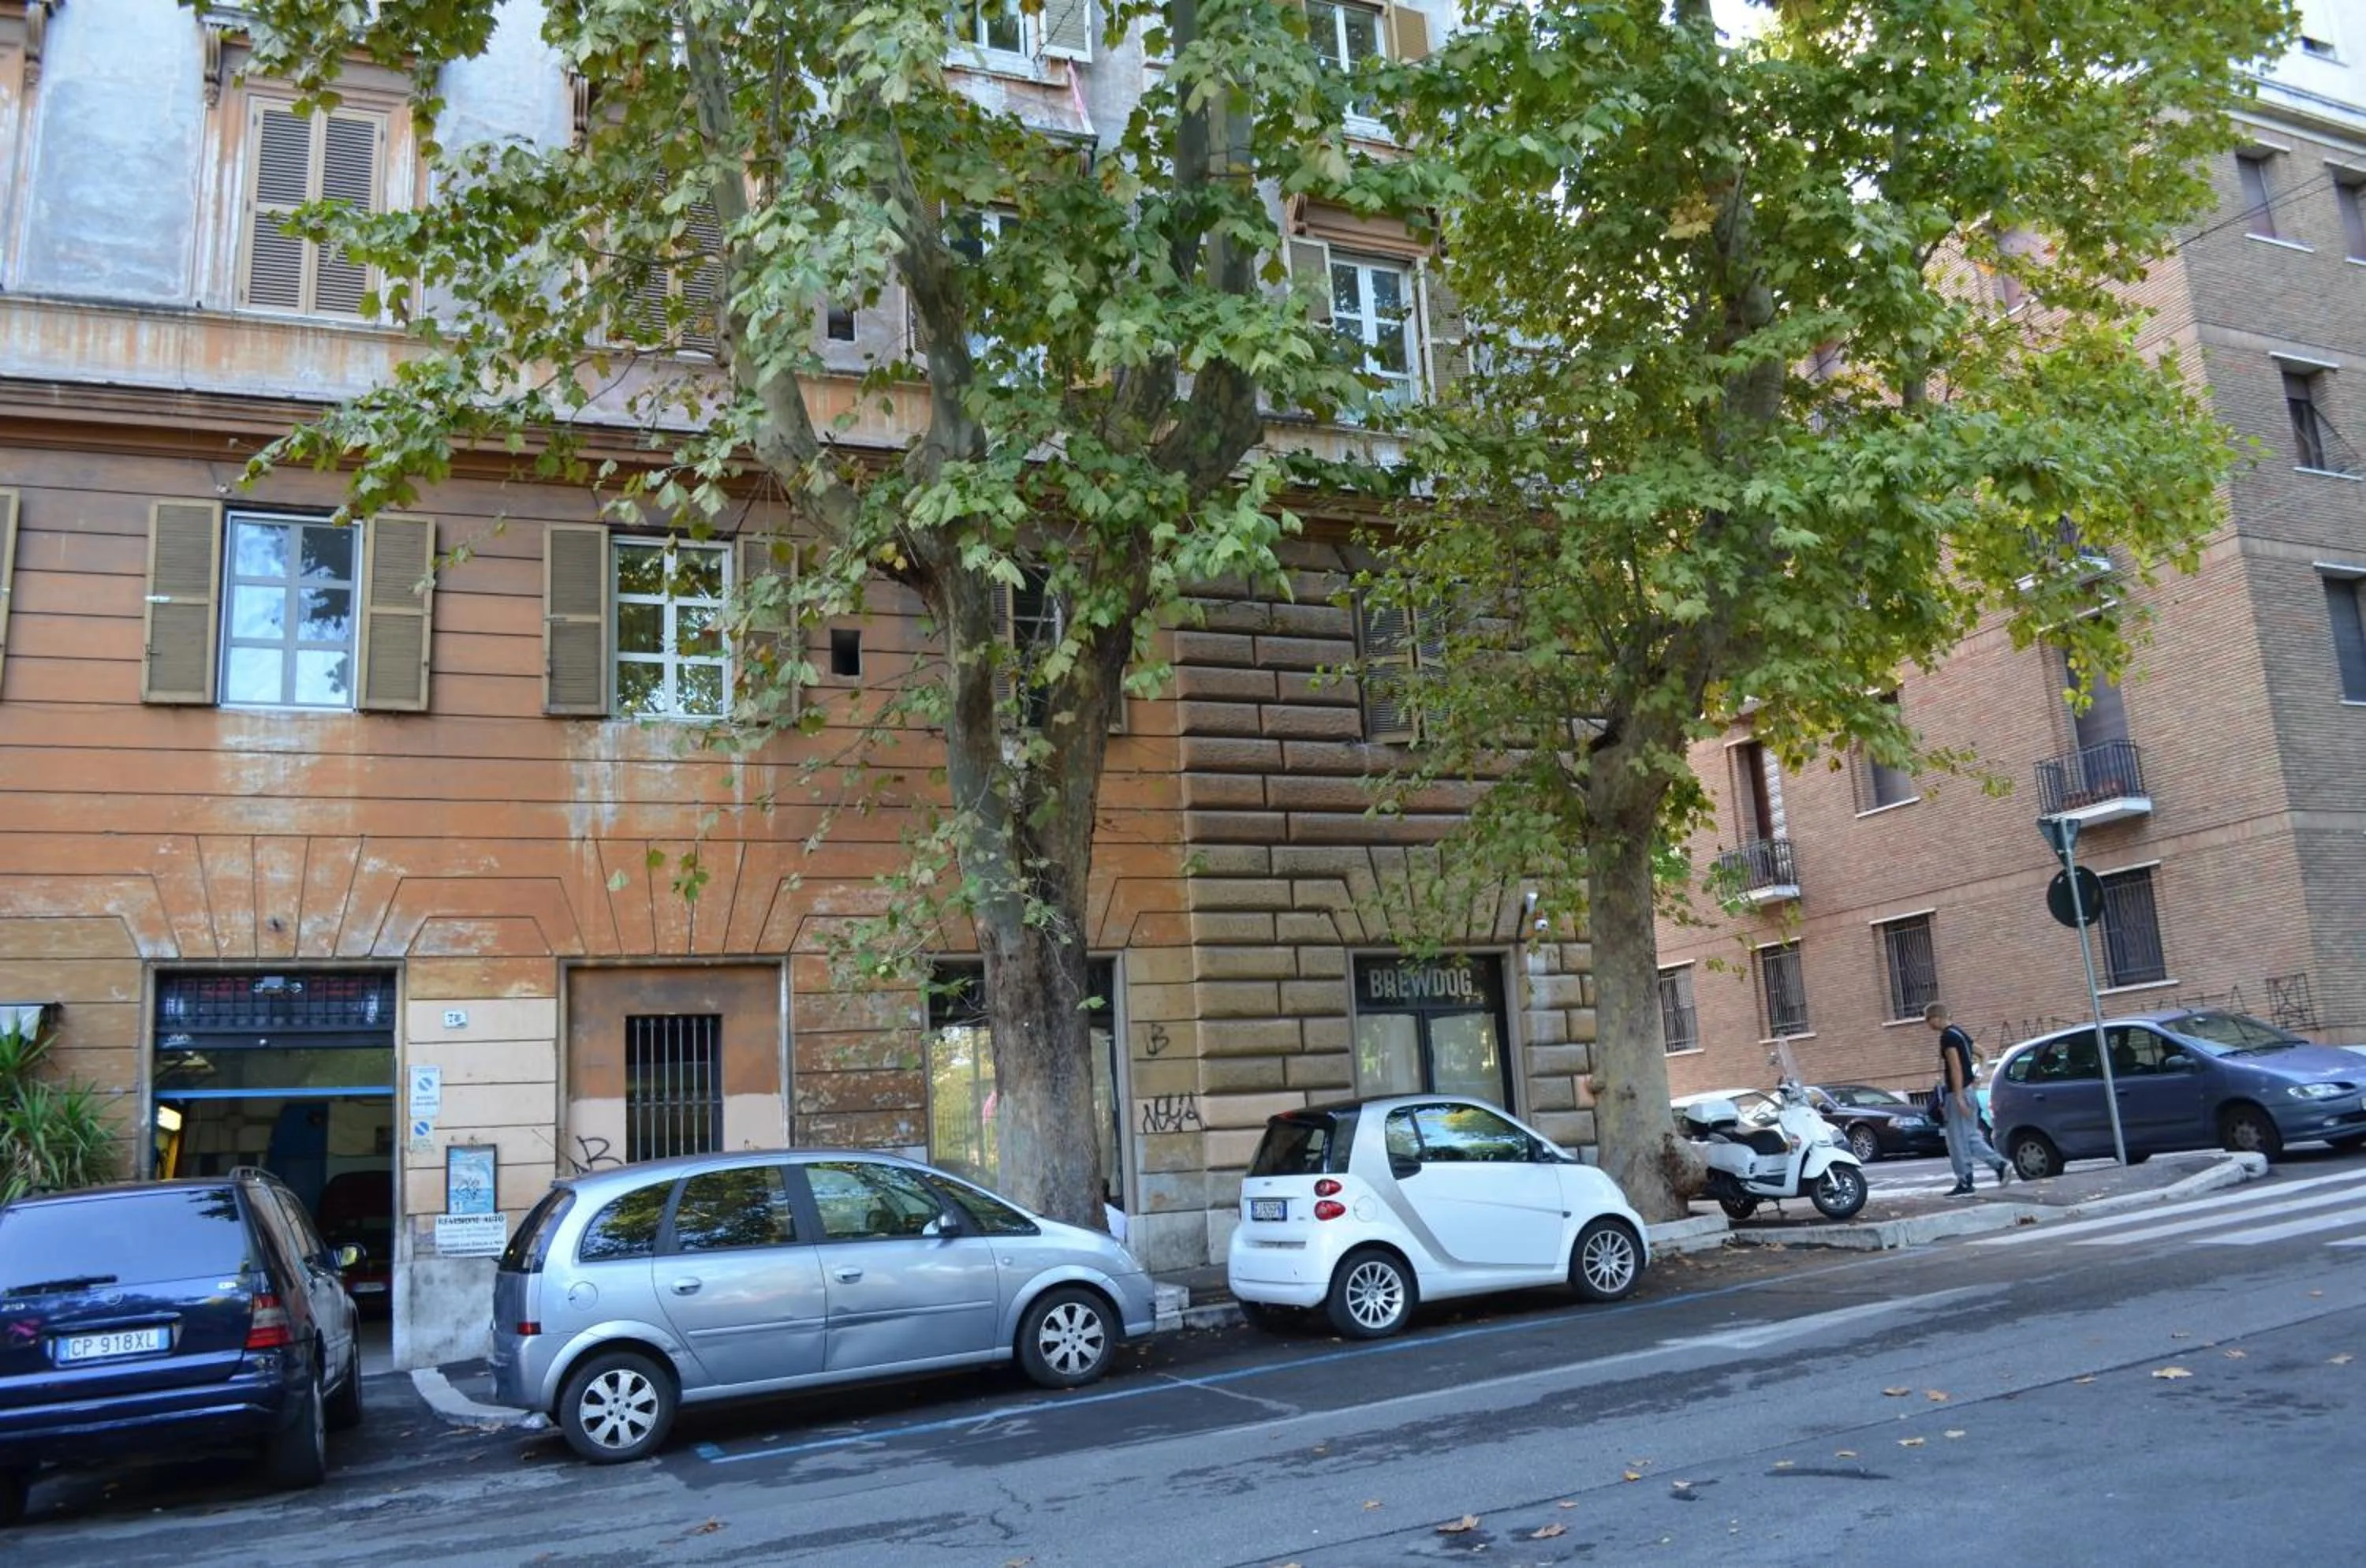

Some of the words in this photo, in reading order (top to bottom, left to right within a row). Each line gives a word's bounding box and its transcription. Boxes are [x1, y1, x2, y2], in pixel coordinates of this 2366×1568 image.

[1369, 969, 1472, 998] BREWDOG
[71, 1338, 94, 1357] CP
[100, 1331, 156, 1353] 918XL
